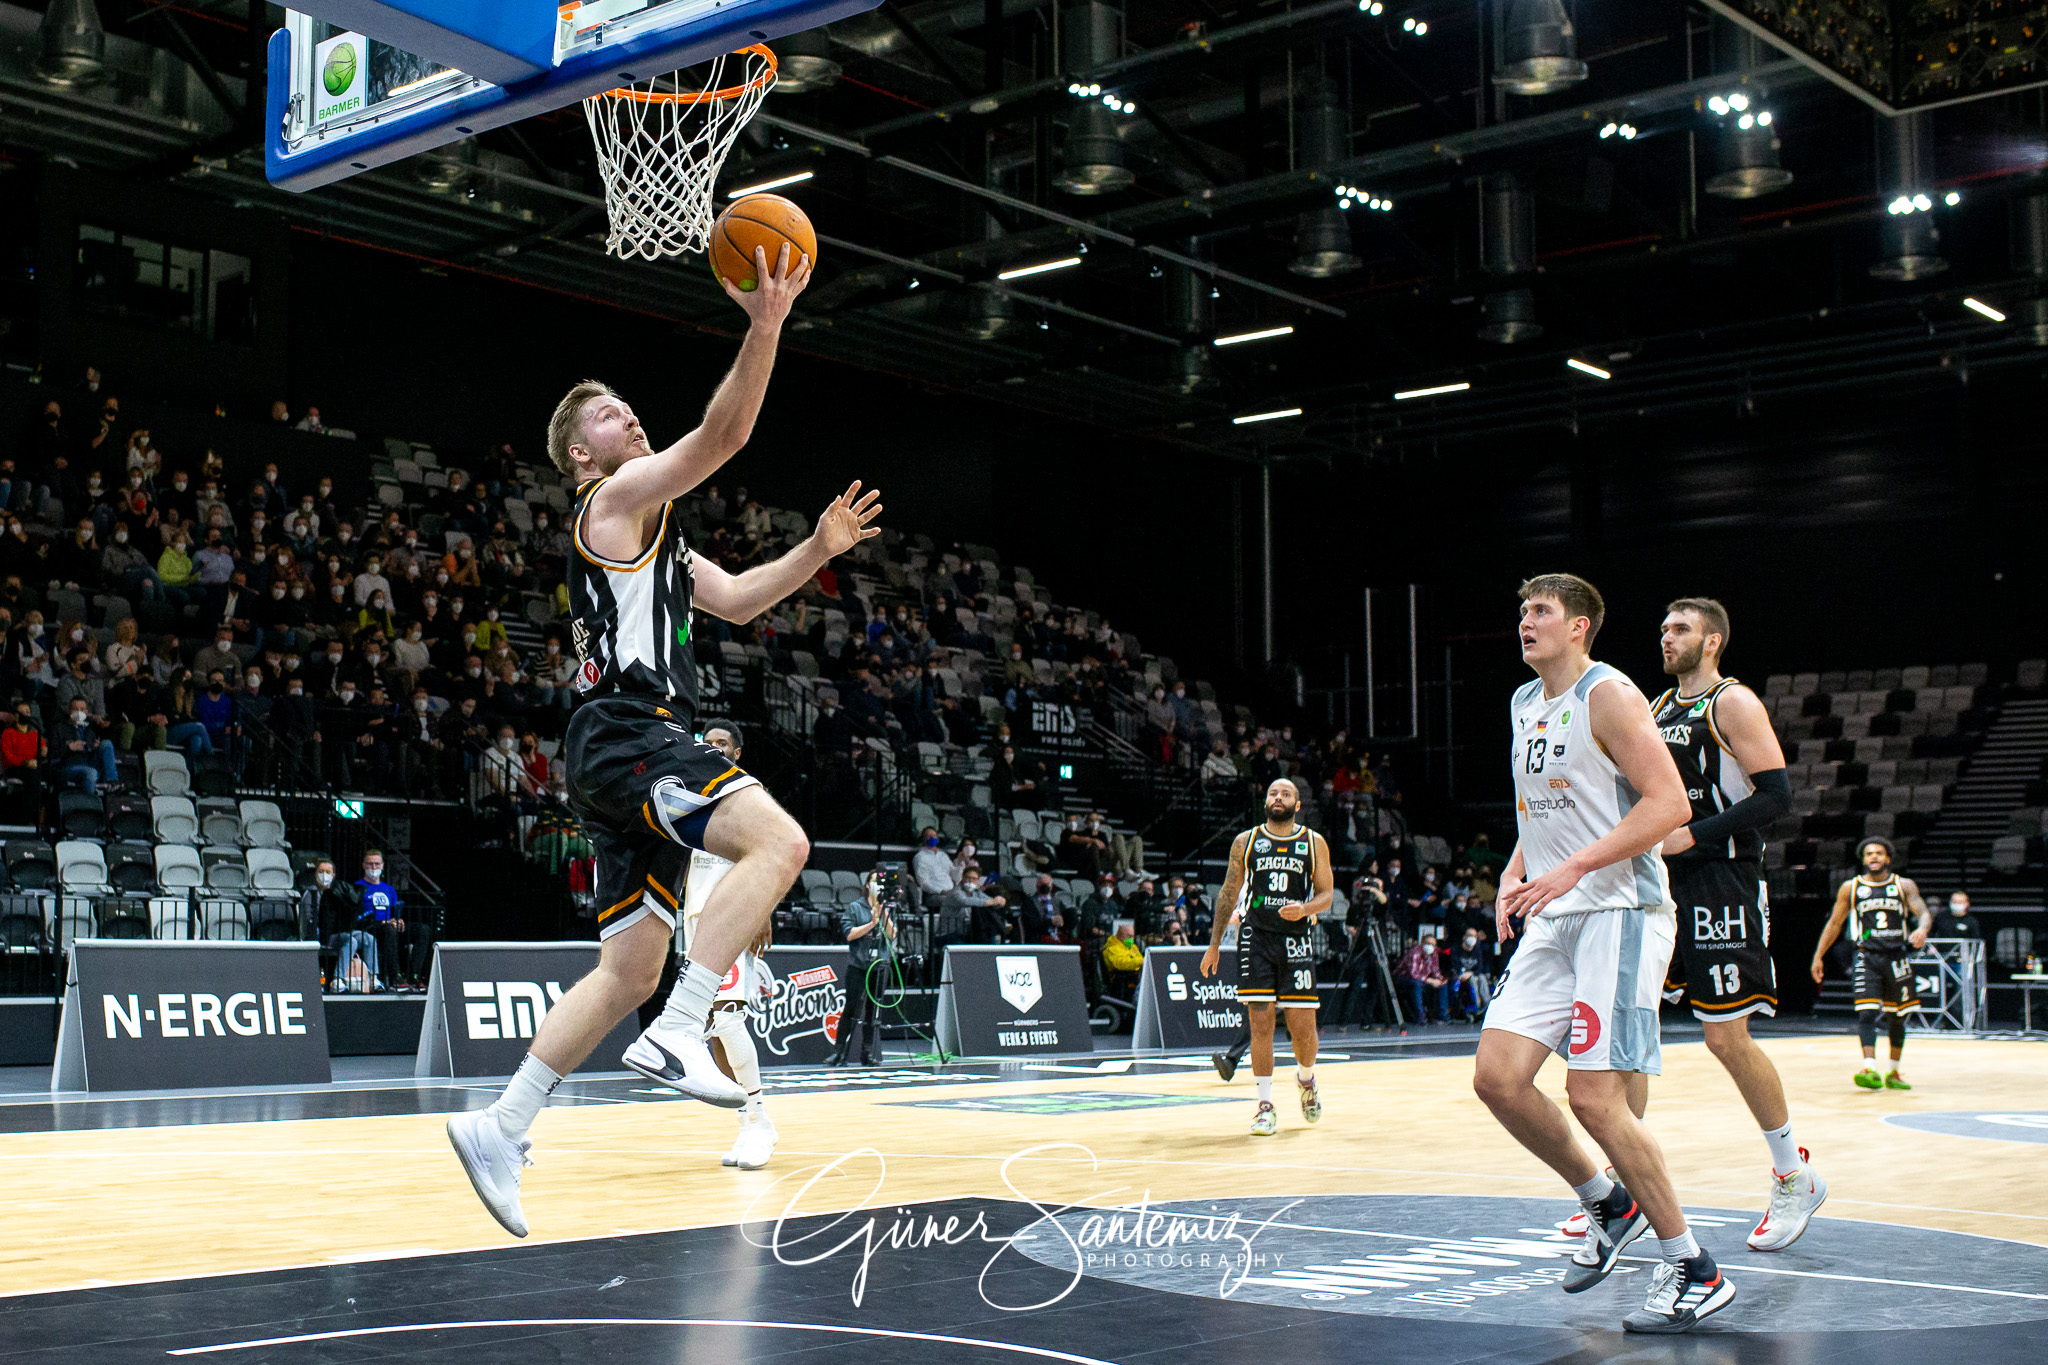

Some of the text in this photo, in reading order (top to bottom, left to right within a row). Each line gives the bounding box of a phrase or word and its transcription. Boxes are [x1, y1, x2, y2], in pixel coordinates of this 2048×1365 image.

[319, 97, 360, 120] BARMER
[1526, 738, 1548, 774] 13
[1256, 856, 1305, 874] EAGLES
[1268, 871, 1288, 892] 30
[1693, 904, 1747, 941] B&H
[1875, 911, 1888, 929] 2
[1286, 936, 1313, 958] B&H
[1293, 969, 1313, 990] 30
[1709, 963, 1741, 996] 13
[754, 980, 846, 1037] Falcons
[1029, 1030, 1059, 1046] EVENTS
